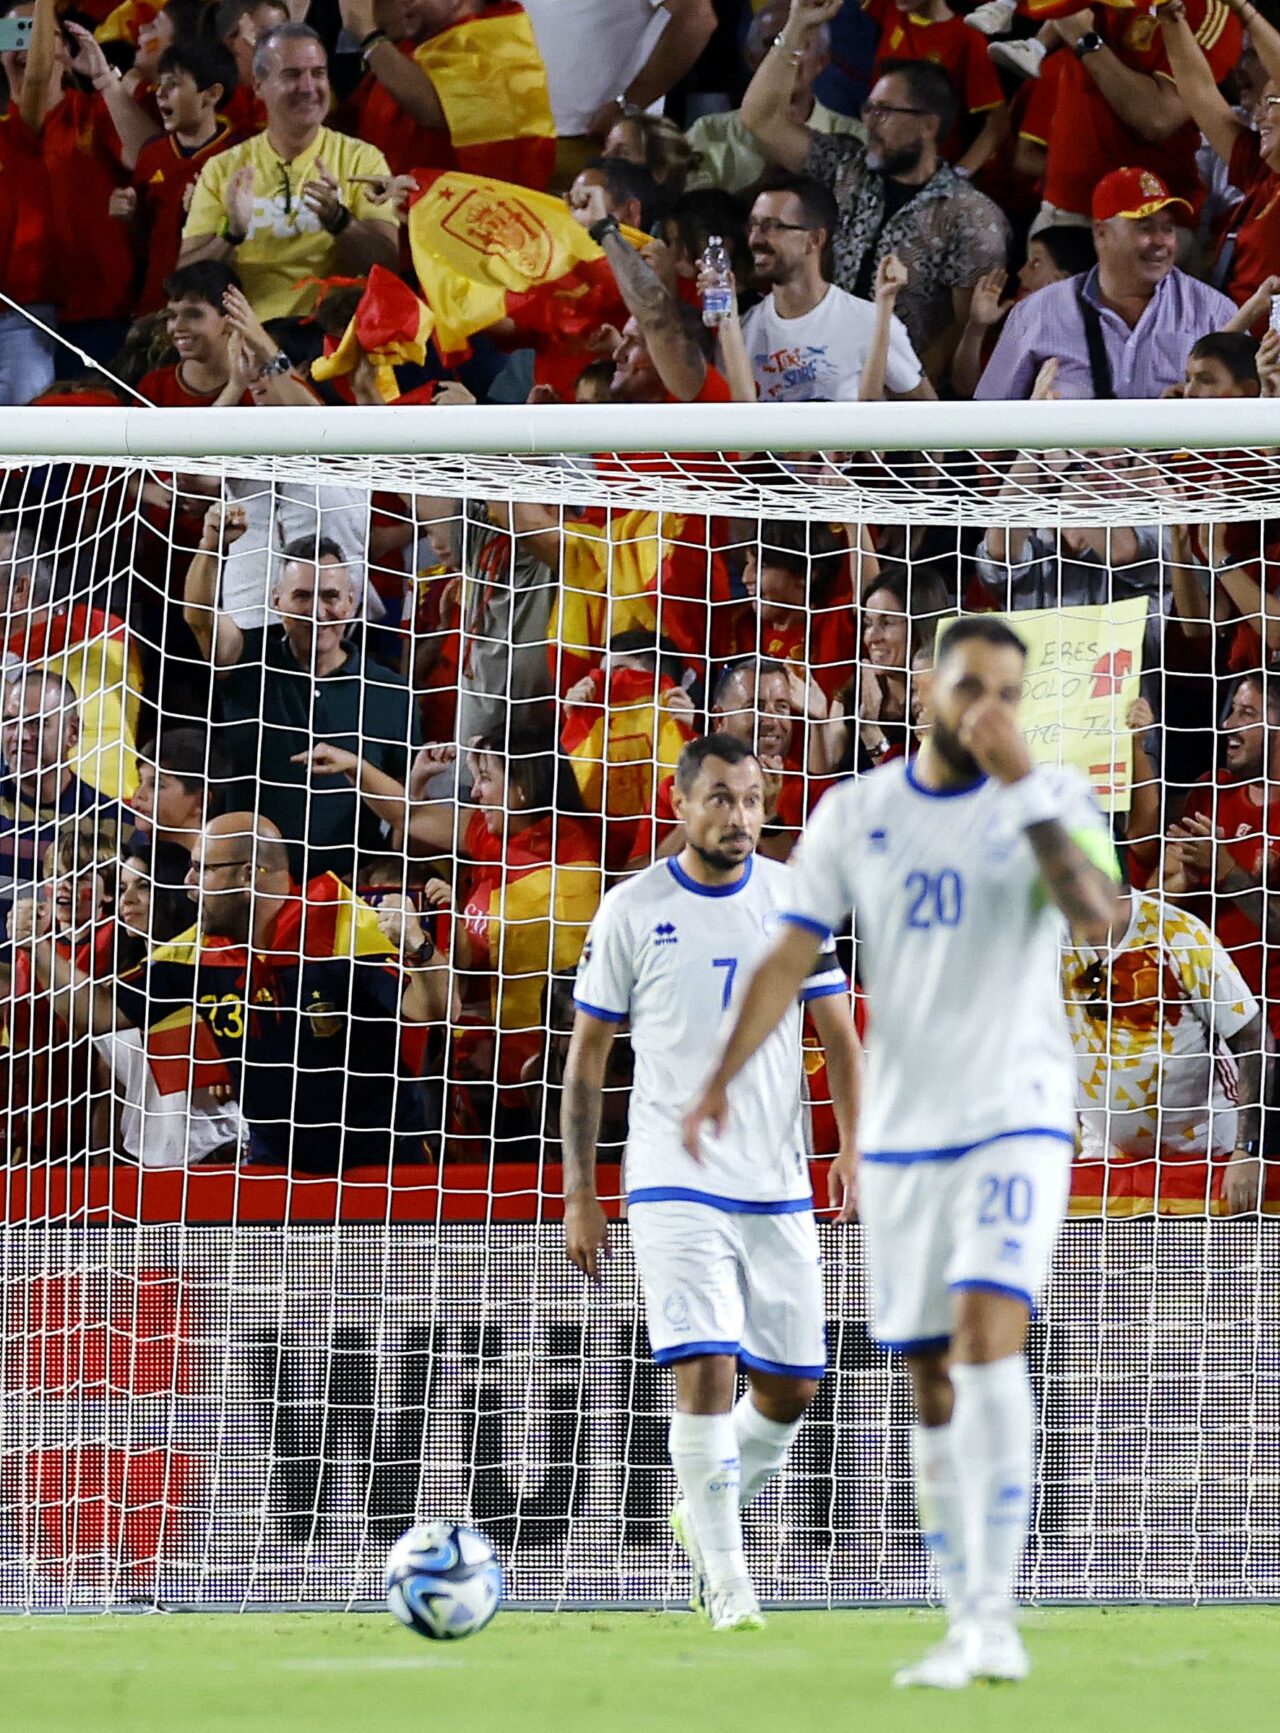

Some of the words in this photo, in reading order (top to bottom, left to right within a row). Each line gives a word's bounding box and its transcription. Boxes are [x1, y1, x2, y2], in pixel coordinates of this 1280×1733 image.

[1041, 640, 1099, 666] ERES
[1021, 677, 1081, 700] DOLO
[904, 867, 963, 929] 20
[712, 957, 738, 1013] 7
[199, 992, 244, 1039] 23
[977, 1173, 1035, 1227] 20
[250, 1322, 1064, 1546] WÜT
